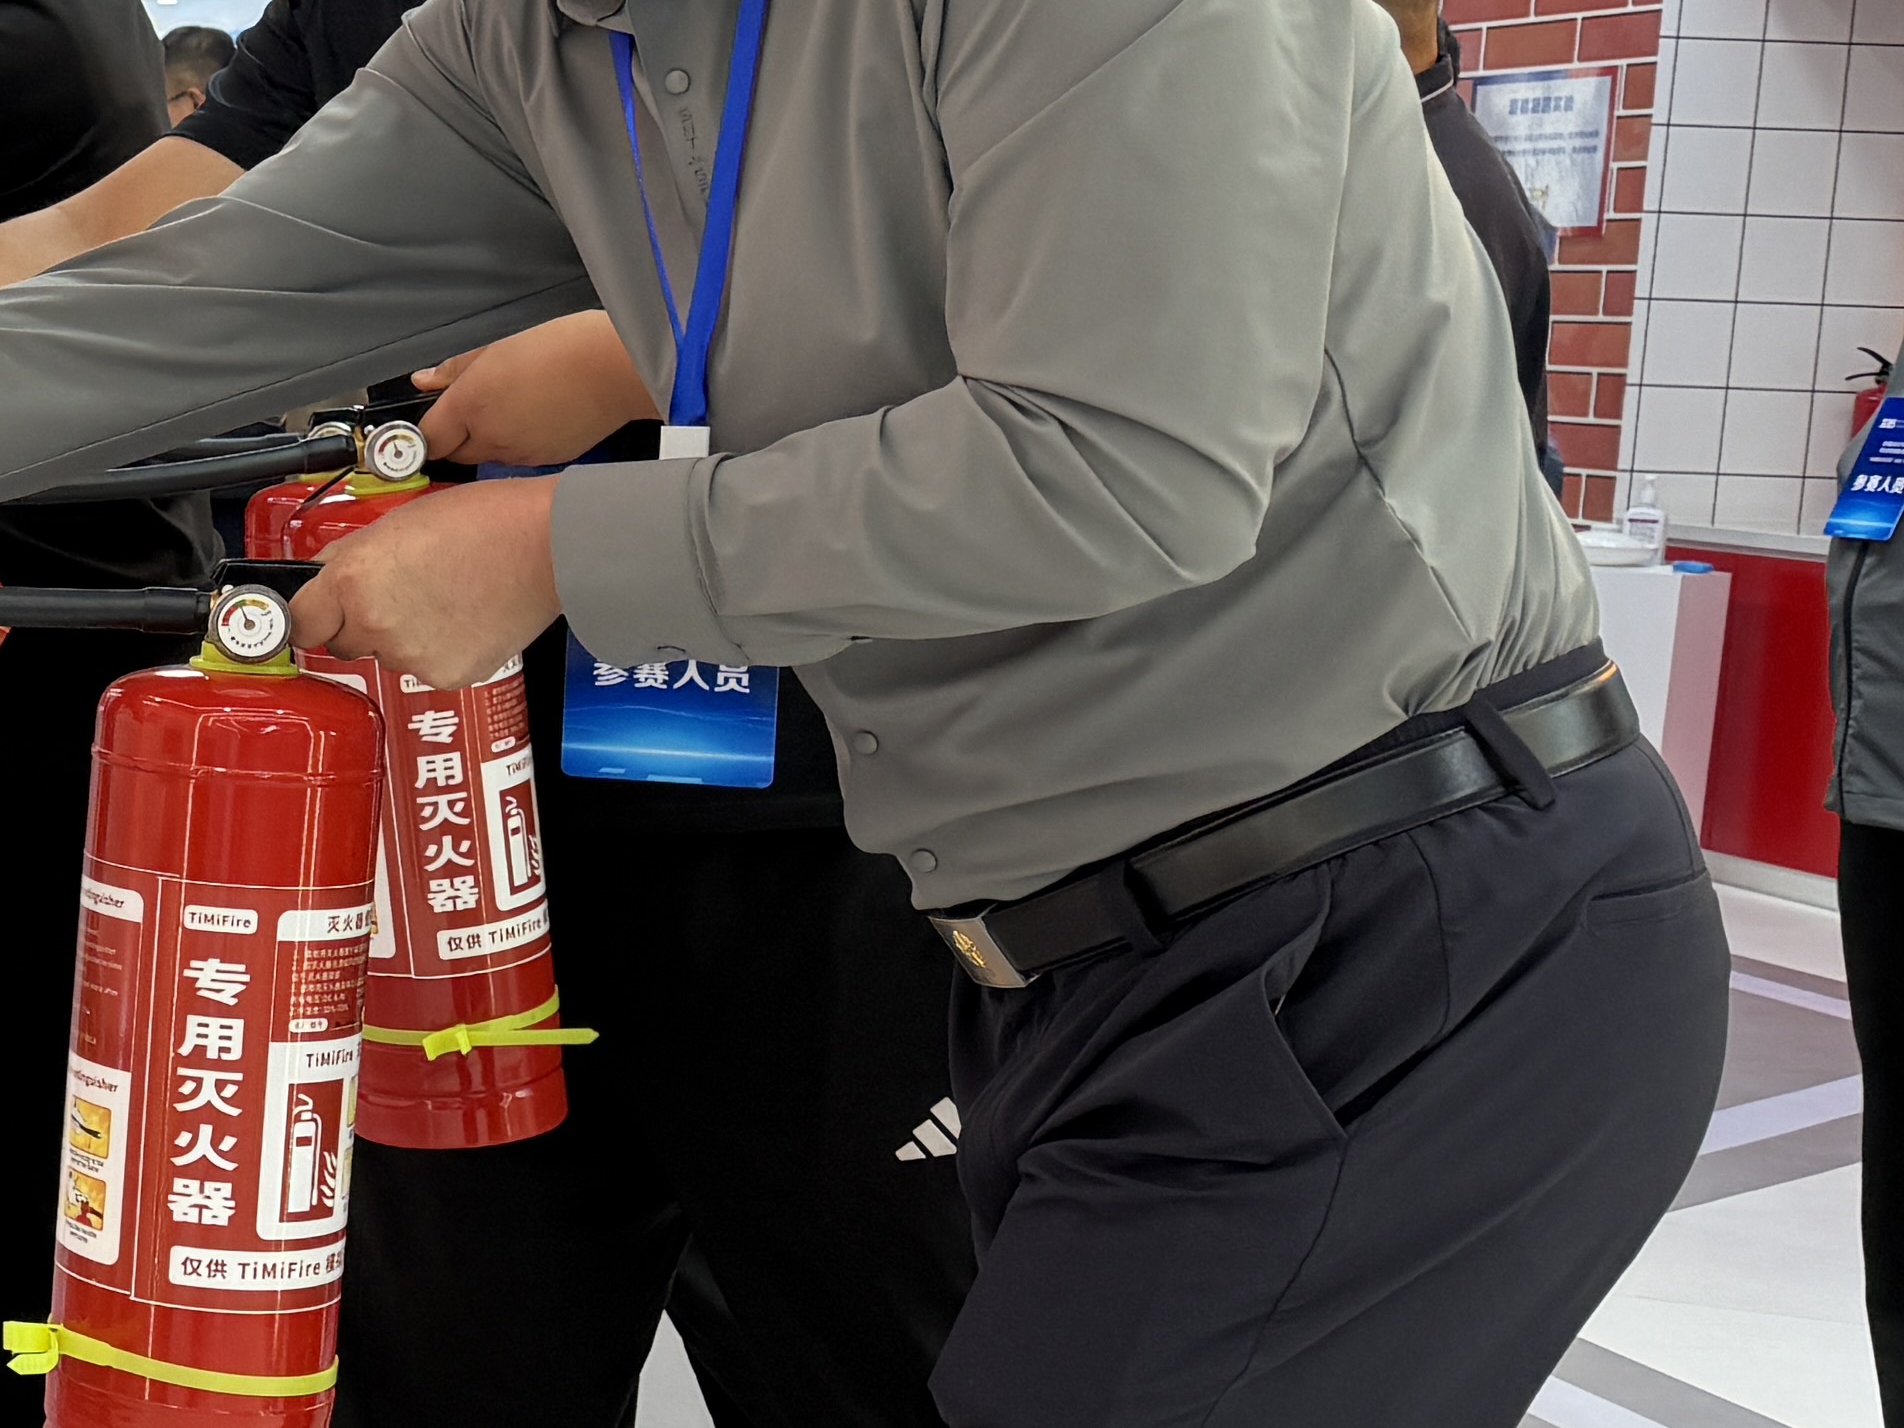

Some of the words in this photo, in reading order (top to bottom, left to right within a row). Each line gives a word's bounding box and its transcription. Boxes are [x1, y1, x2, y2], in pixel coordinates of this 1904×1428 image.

[592, 660, 751, 695] 参赛人员
[407, 709, 480, 913] 专用灭火器
[187, 910, 252, 930] TiMiFire
[446, 932, 483, 954] 仅供
[488, 917, 542, 945] TiMiFire
[305, 1048, 354, 1069] TiMiFire
[167, 957, 252, 1228] 专用灭火器
[180, 1255, 228, 1279] 仅供
[238, 1258, 321, 1281] TiMiFire
